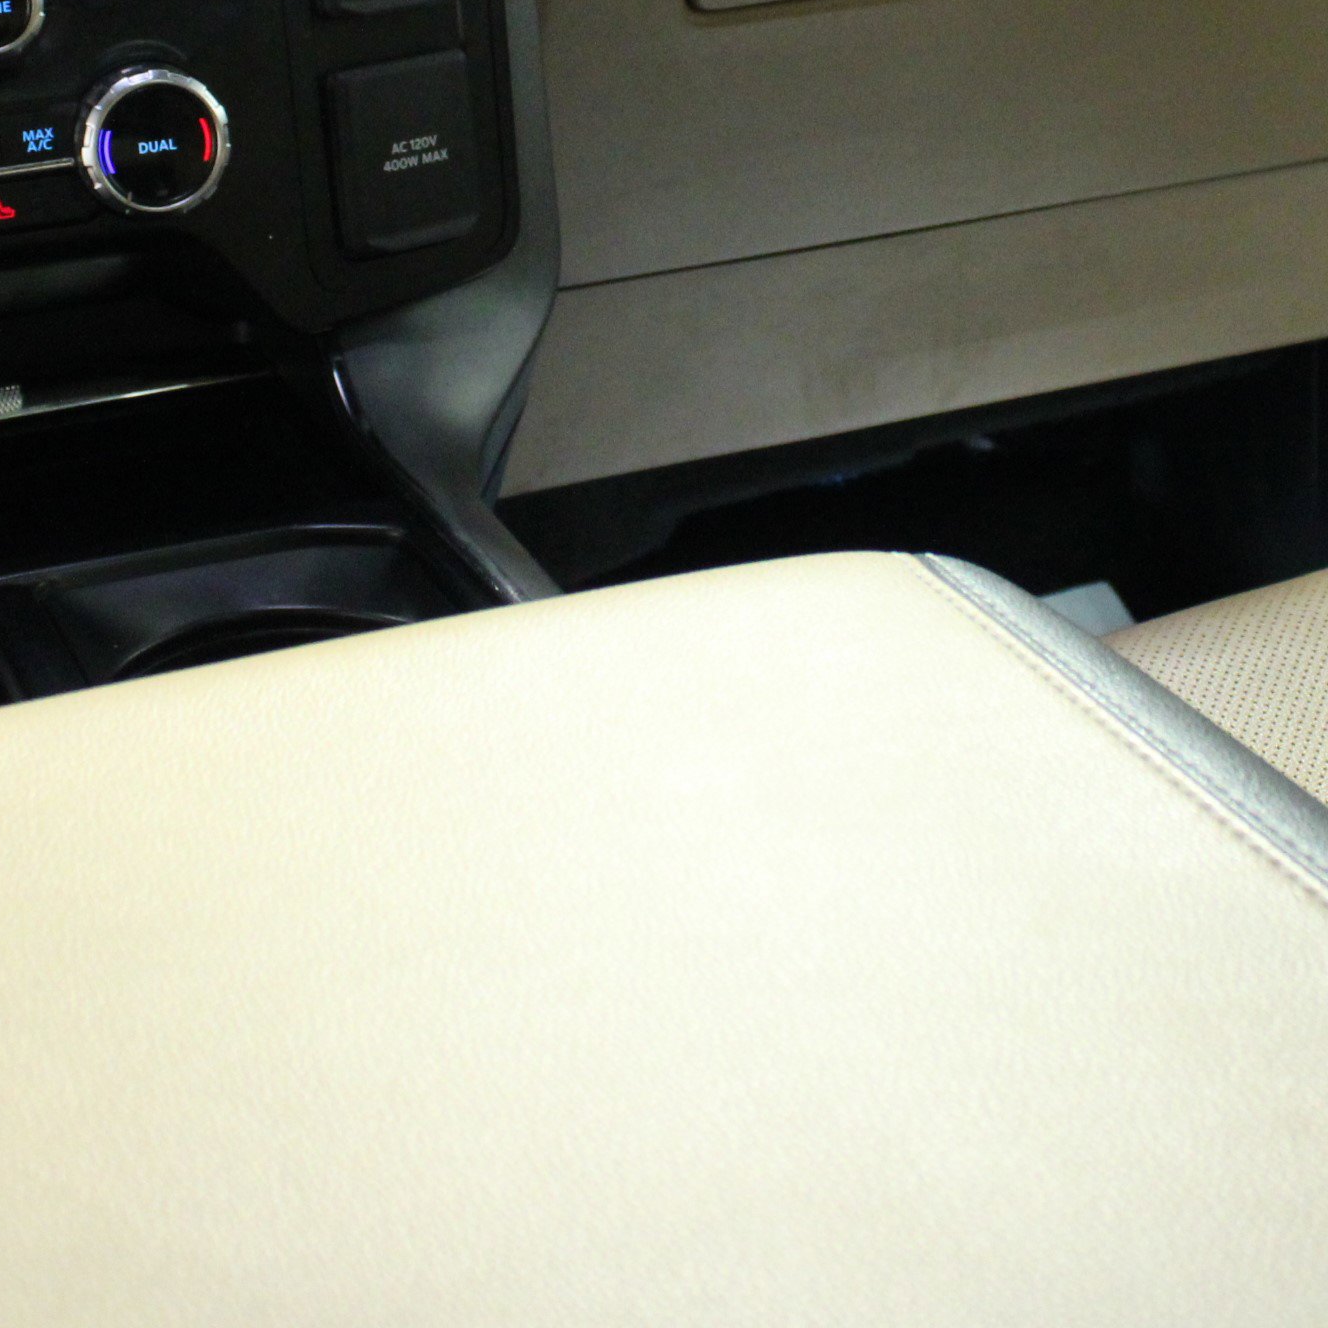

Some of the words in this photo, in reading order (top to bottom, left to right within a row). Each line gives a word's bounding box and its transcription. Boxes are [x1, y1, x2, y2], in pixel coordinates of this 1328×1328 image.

[22, 127, 54, 143] MAX
[26, 138, 53, 153] A/C
[137, 137, 178, 154] DUAL
[391, 140, 408, 156] AC
[409, 134, 438, 152] 120V
[382, 155, 419, 173] 400W
[421, 147, 449, 166] MAX
